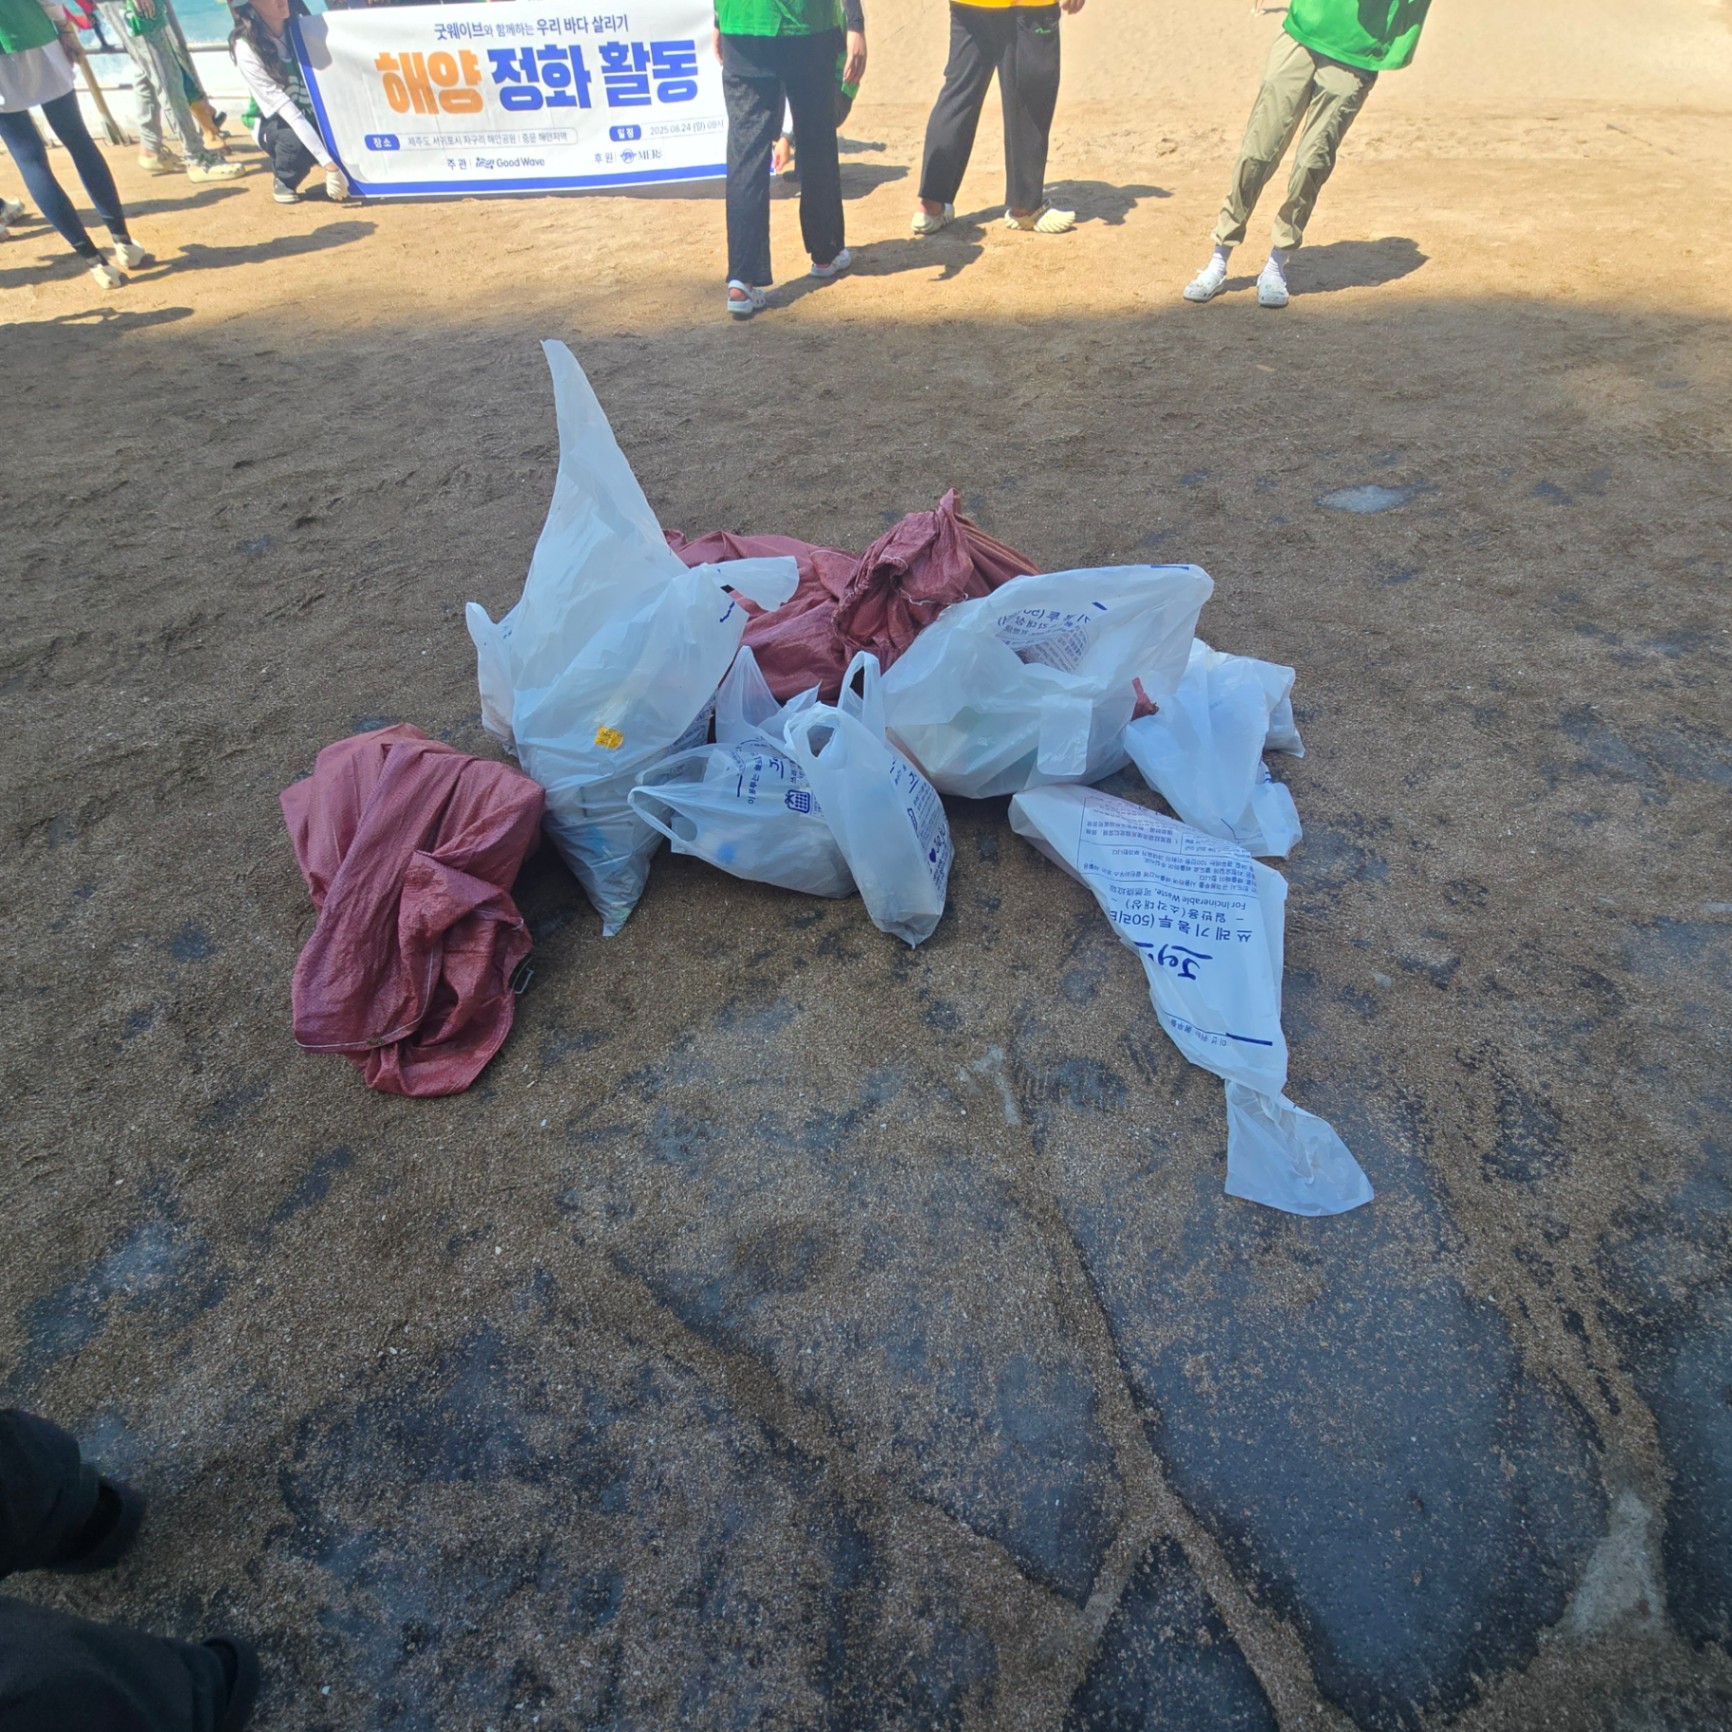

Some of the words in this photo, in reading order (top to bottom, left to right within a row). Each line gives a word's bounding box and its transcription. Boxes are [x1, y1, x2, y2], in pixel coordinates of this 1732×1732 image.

[434, 21, 494, 41] 굿웨이브와
[495, 23, 535, 38] 함께하는
[536, 17, 562, 36] 우리
[563, 15, 588, 35] 바다
[591, 13, 629, 33] 살리기
[374, 48, 484, 115] 해양
[486, 43, 592, 112] 정화
[598, 40, 698, 108] 활동
[496, 157, 520, 168] Good
[520, 156, 545, 167] Wave
[1181, 896, 1230, 910] Incinerable
[1231, 901, 1246, 911] For
